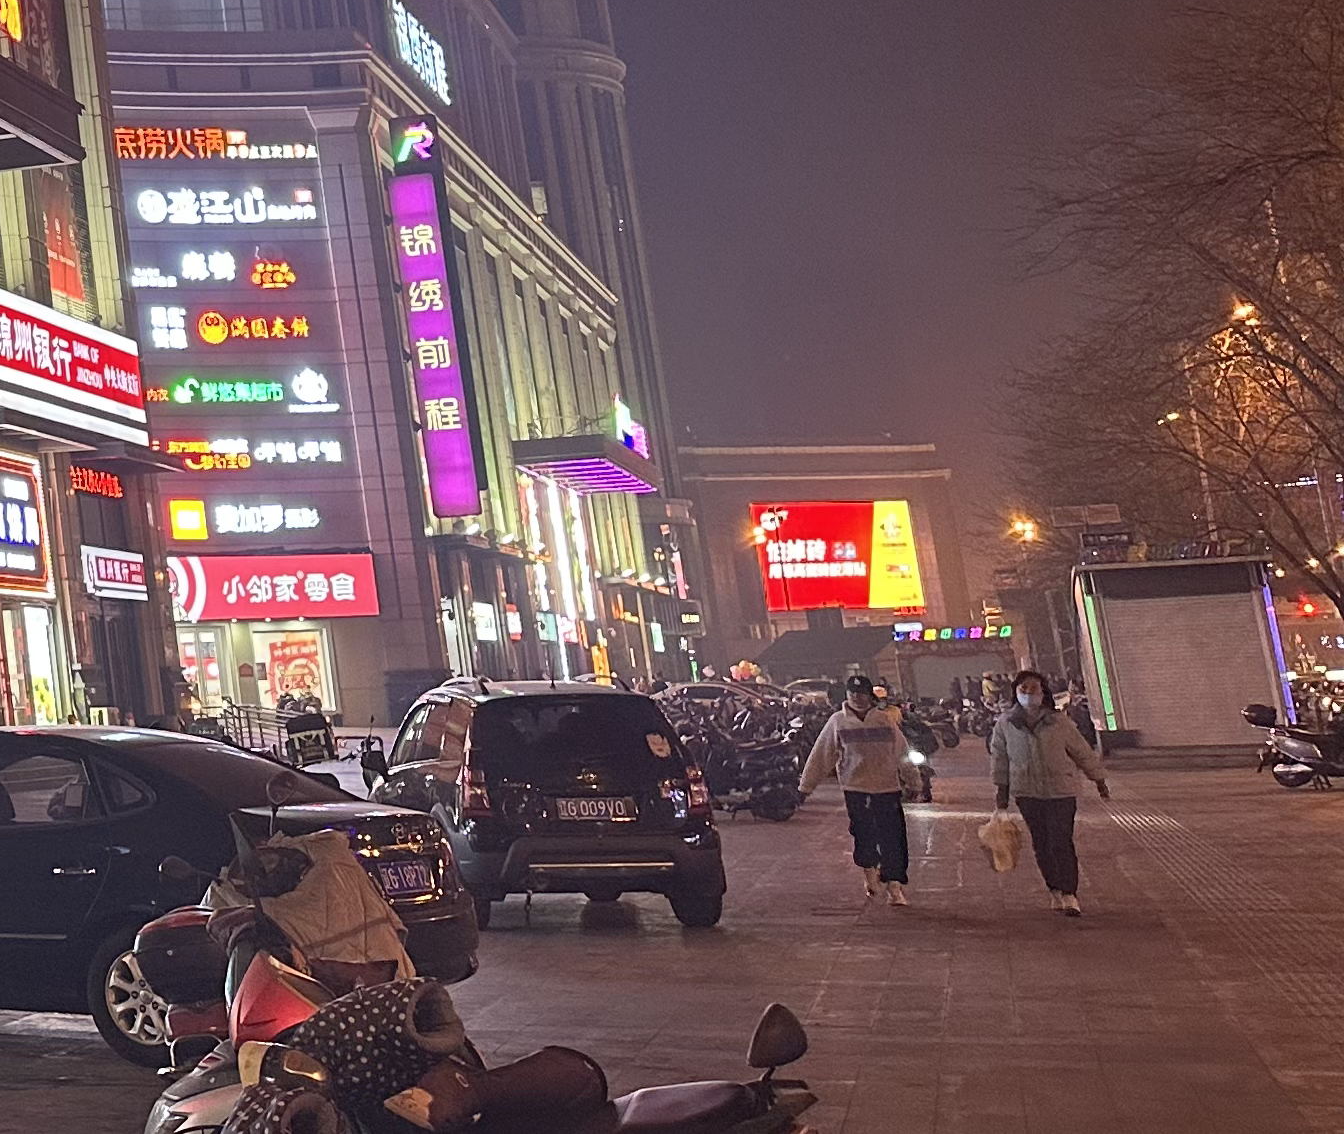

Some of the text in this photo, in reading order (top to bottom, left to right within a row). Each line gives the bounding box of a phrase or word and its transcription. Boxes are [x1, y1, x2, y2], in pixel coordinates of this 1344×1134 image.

[400, 224, 461, 432] 锦绣前程
[223, 570, 356, 604] 小邻家零食
